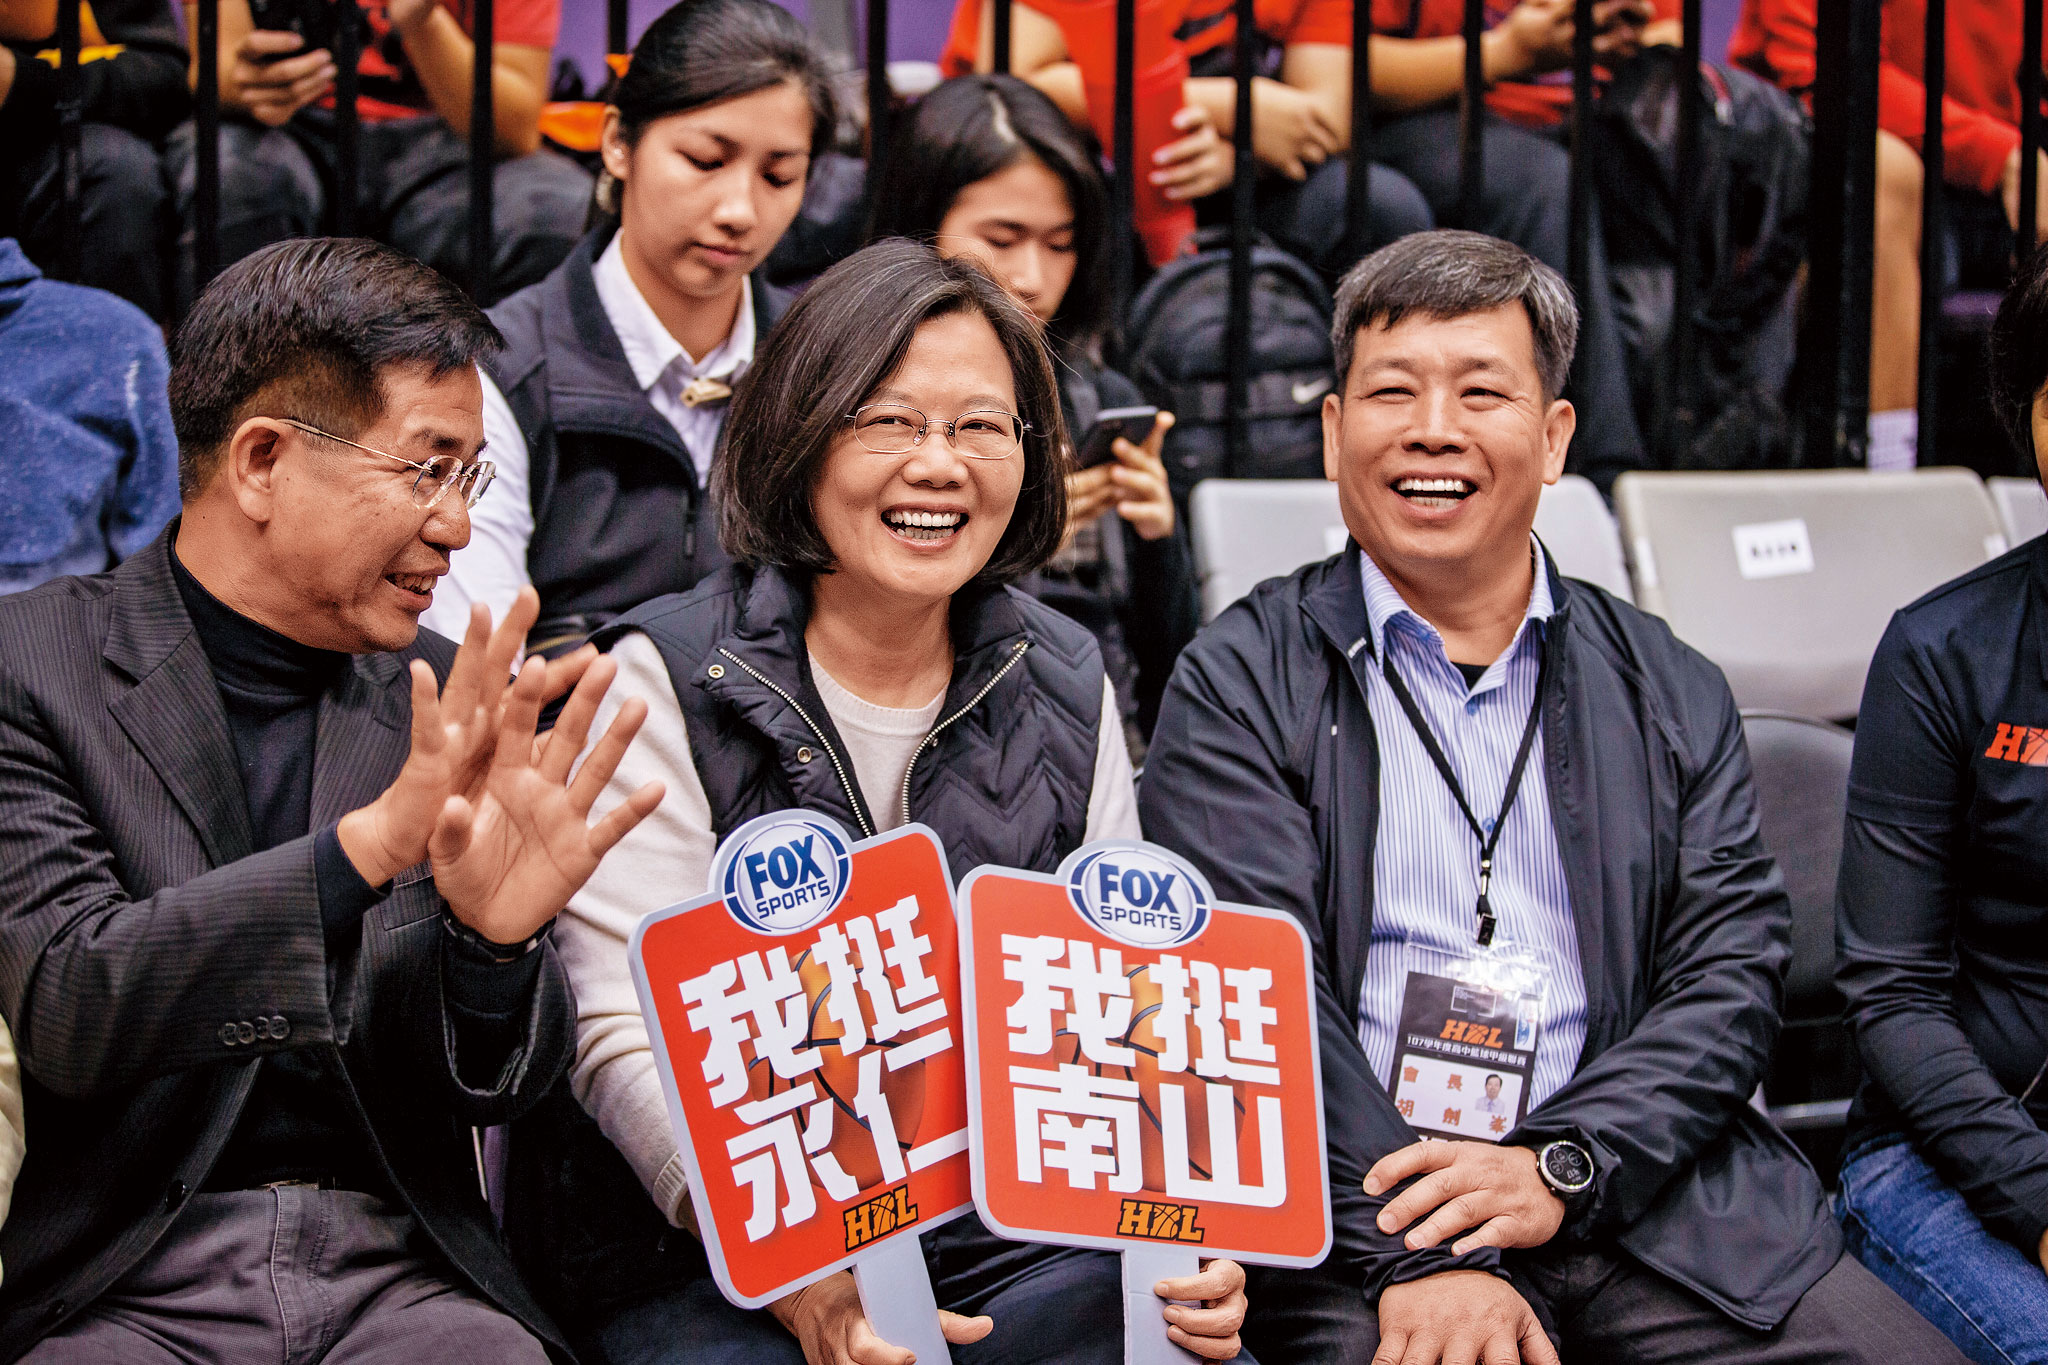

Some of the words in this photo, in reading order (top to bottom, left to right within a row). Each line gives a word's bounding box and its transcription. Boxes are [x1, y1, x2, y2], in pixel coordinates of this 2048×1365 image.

[1984, 722, 2048, 767] HB
[745, 834, 825, 900] FOX
[1099, 863, 1179, 914] FOX
[756, 879, 830, 919] SPORTS
[1100, 905, 1182, 931] SPORTS
[680, 894, 949, 1110] 我挺
[1001, 933, 1280, 1085] 我挺
[1440, 1019, 1504, 1048] HBL
[727, 1028, 968, 1242] 永仁
[1010, 1065, 1287, 1208] 南山
[843, 1184, 919, 1251] HBL
[1116, 1198, 1204, 1243] HBL
